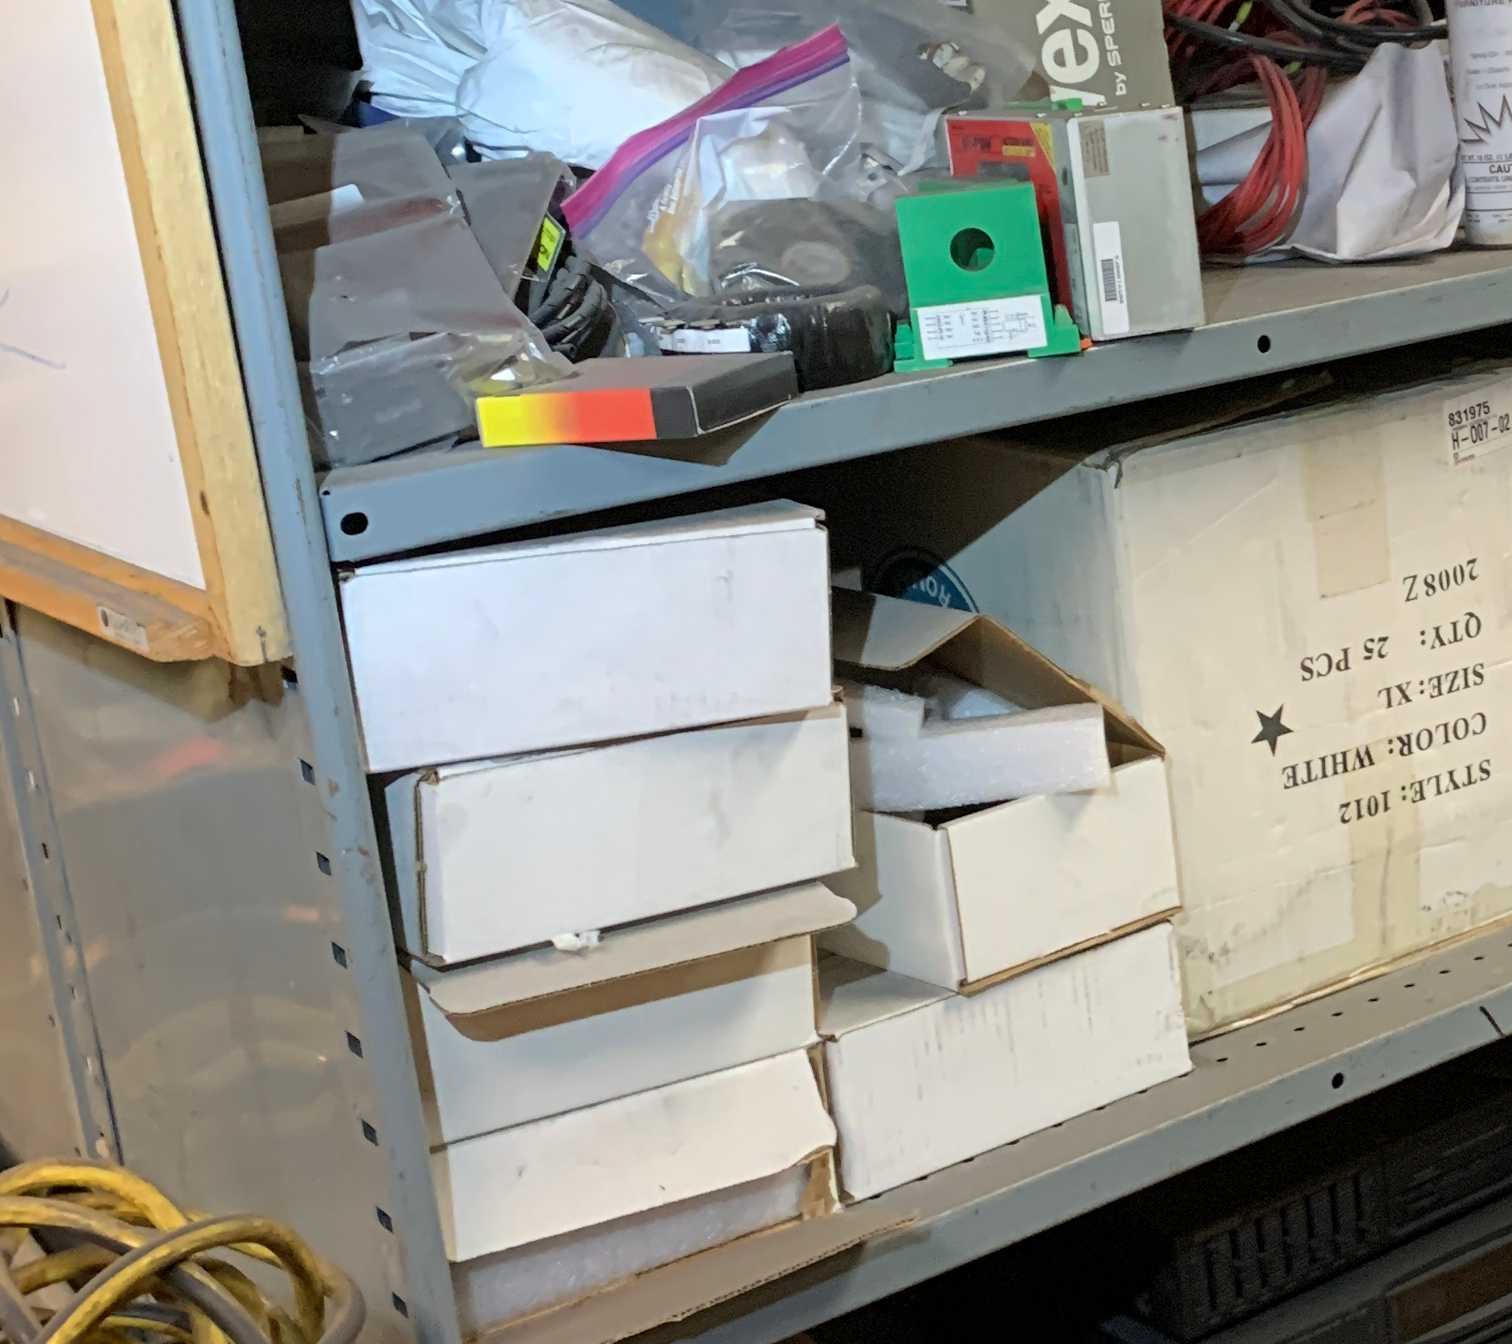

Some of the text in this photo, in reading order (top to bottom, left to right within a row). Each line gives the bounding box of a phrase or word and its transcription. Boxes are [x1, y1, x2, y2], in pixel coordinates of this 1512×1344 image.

[1113, 71, 1127, 96] by
[1448, 401, 1490, 427] 831975
[1451, 413, 1511, 451] H-007-02
[1300, 611, 1482, 682] QTY: 25 PCS
[1281, 712, 1487, 790] COLOR: WHITE
[1339, 759, 1491, 824] STYLE: 1012
